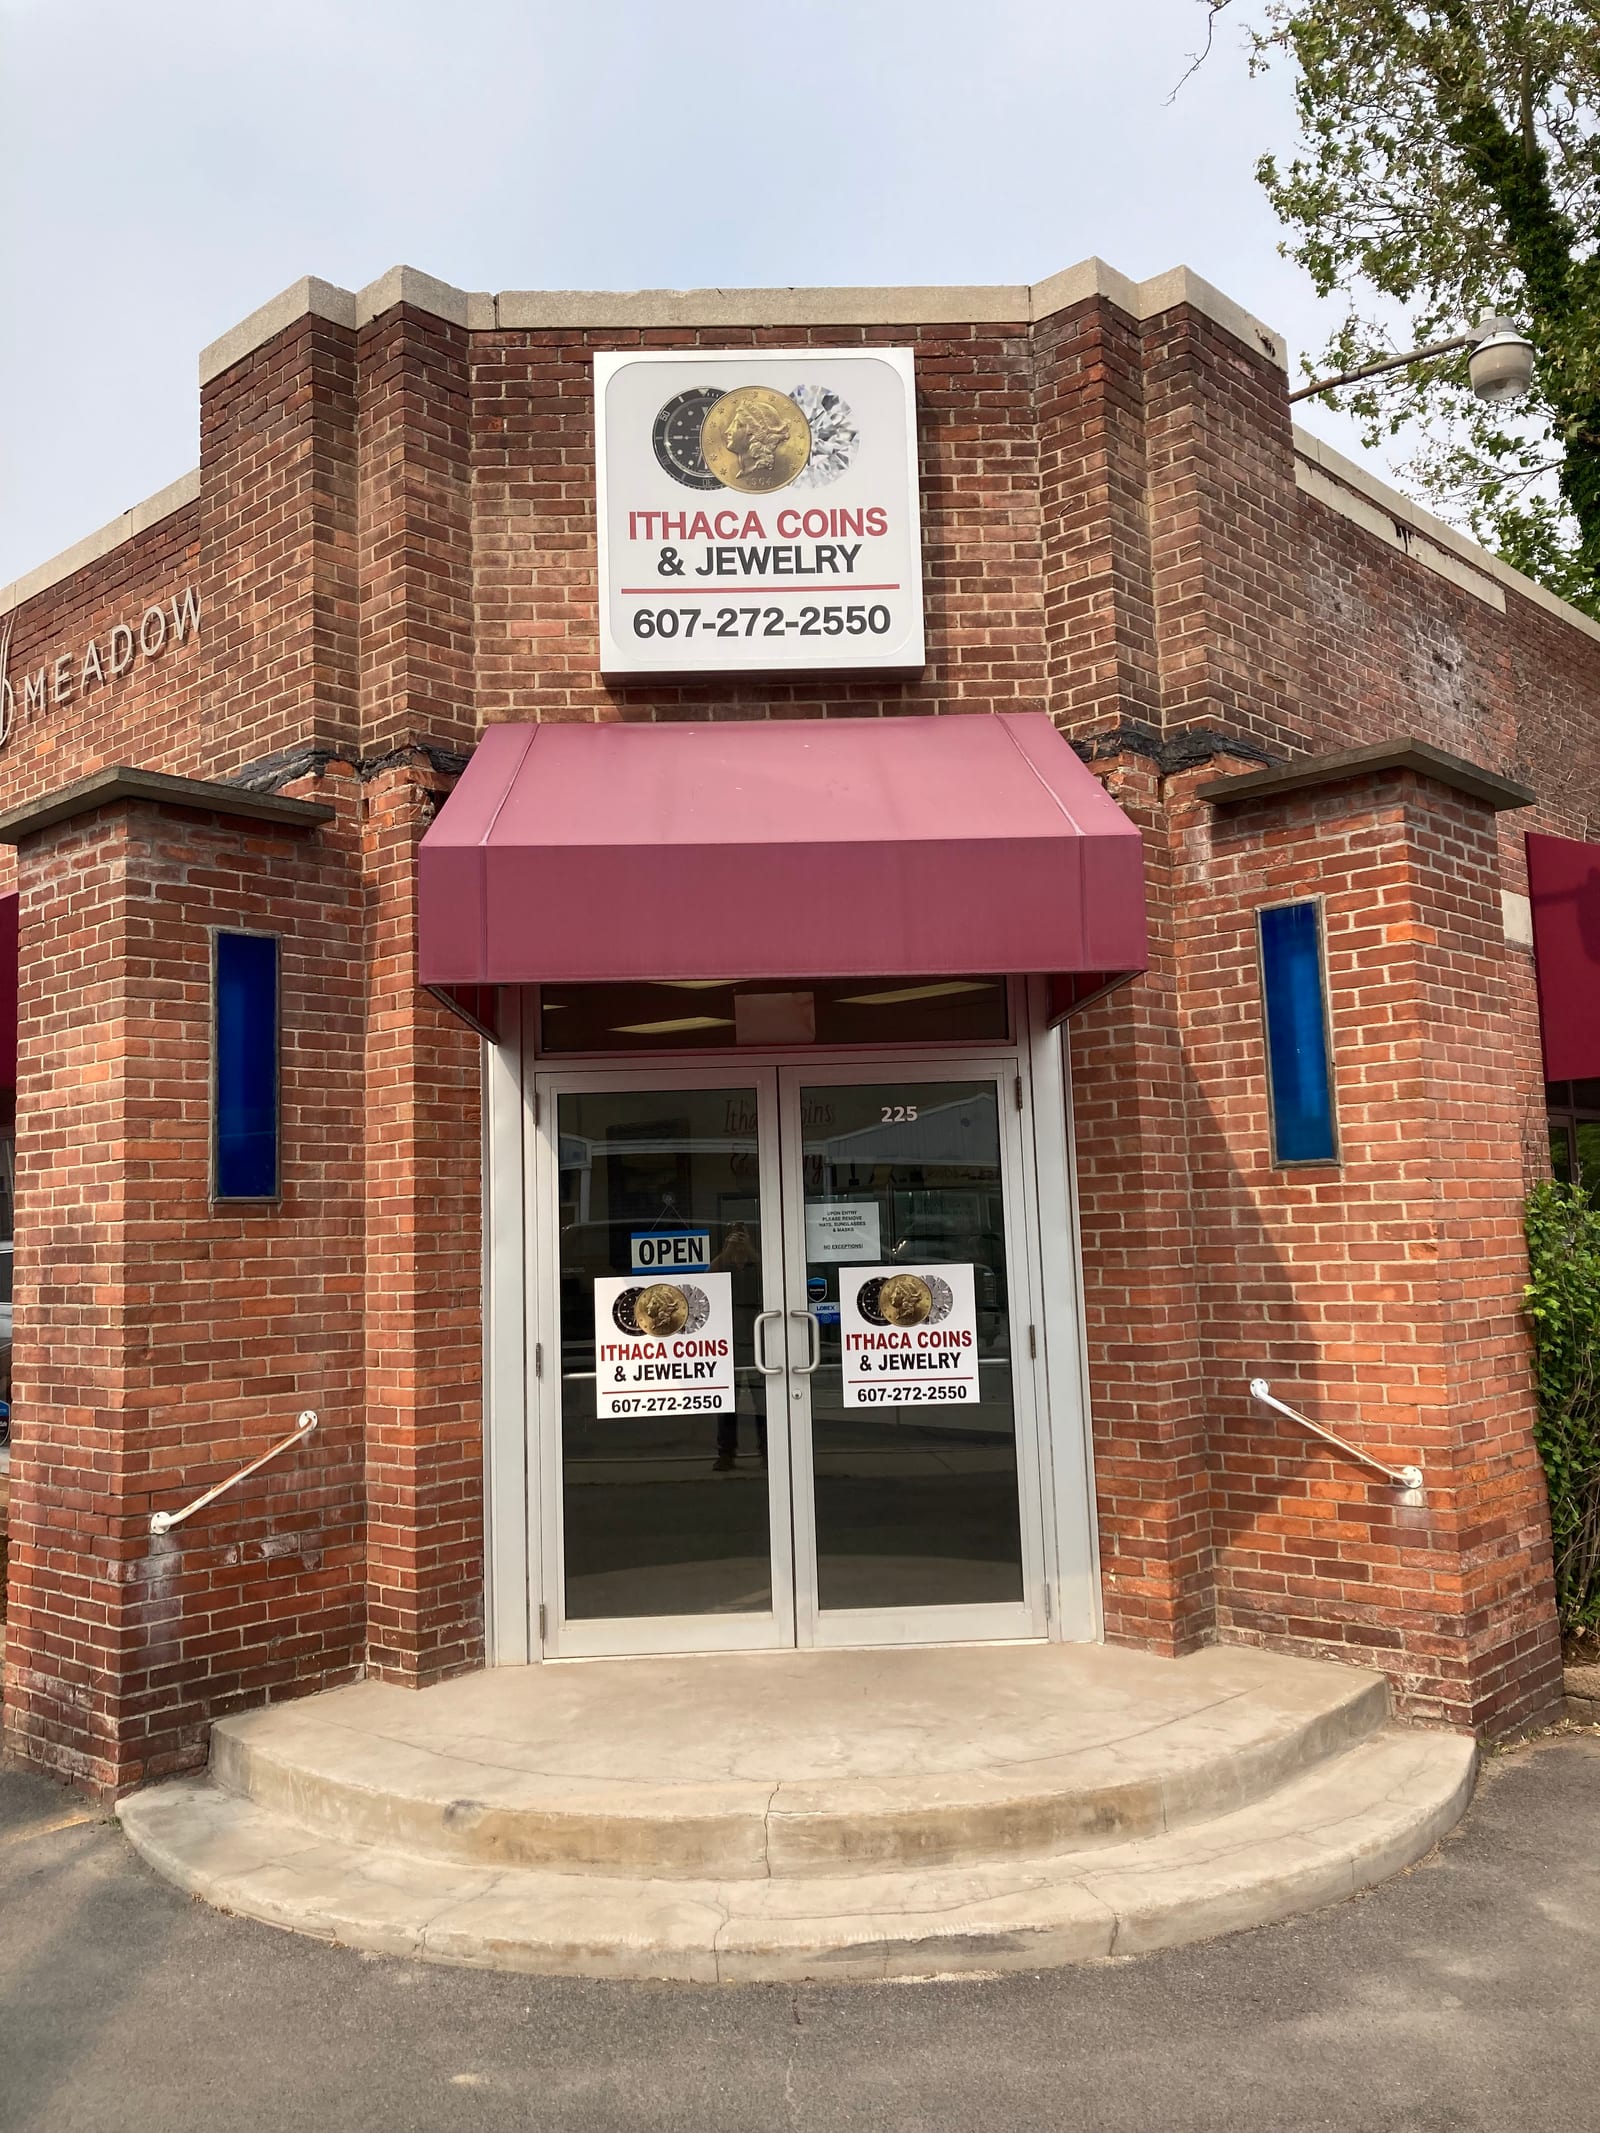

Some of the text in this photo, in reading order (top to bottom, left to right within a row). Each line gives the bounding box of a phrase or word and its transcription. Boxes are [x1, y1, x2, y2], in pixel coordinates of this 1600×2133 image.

[629, 507, 889, 540] ITHACA COINS
[657, 543, 862, 576] & JEWELRY
[633, 605, 891, 638] 607-272-2550
[24, 586, 201, 720] MEADOW
[880, 1105, 919, 1123] 225
[638, 1236, 704, 1266] OPEN
[600, 1339, 729, 1361] ITHACA COINS
[846, 1330, 972, 1351] ITHACA COINS
[614, 1361, 717, 1382] & JEWELRY
[860, 1352, 961, 1371] & JEWELRY
[611, 1394, 722, 1413] 607-272-2550
[857, 1385, 967, 1402] 607-272-2550
